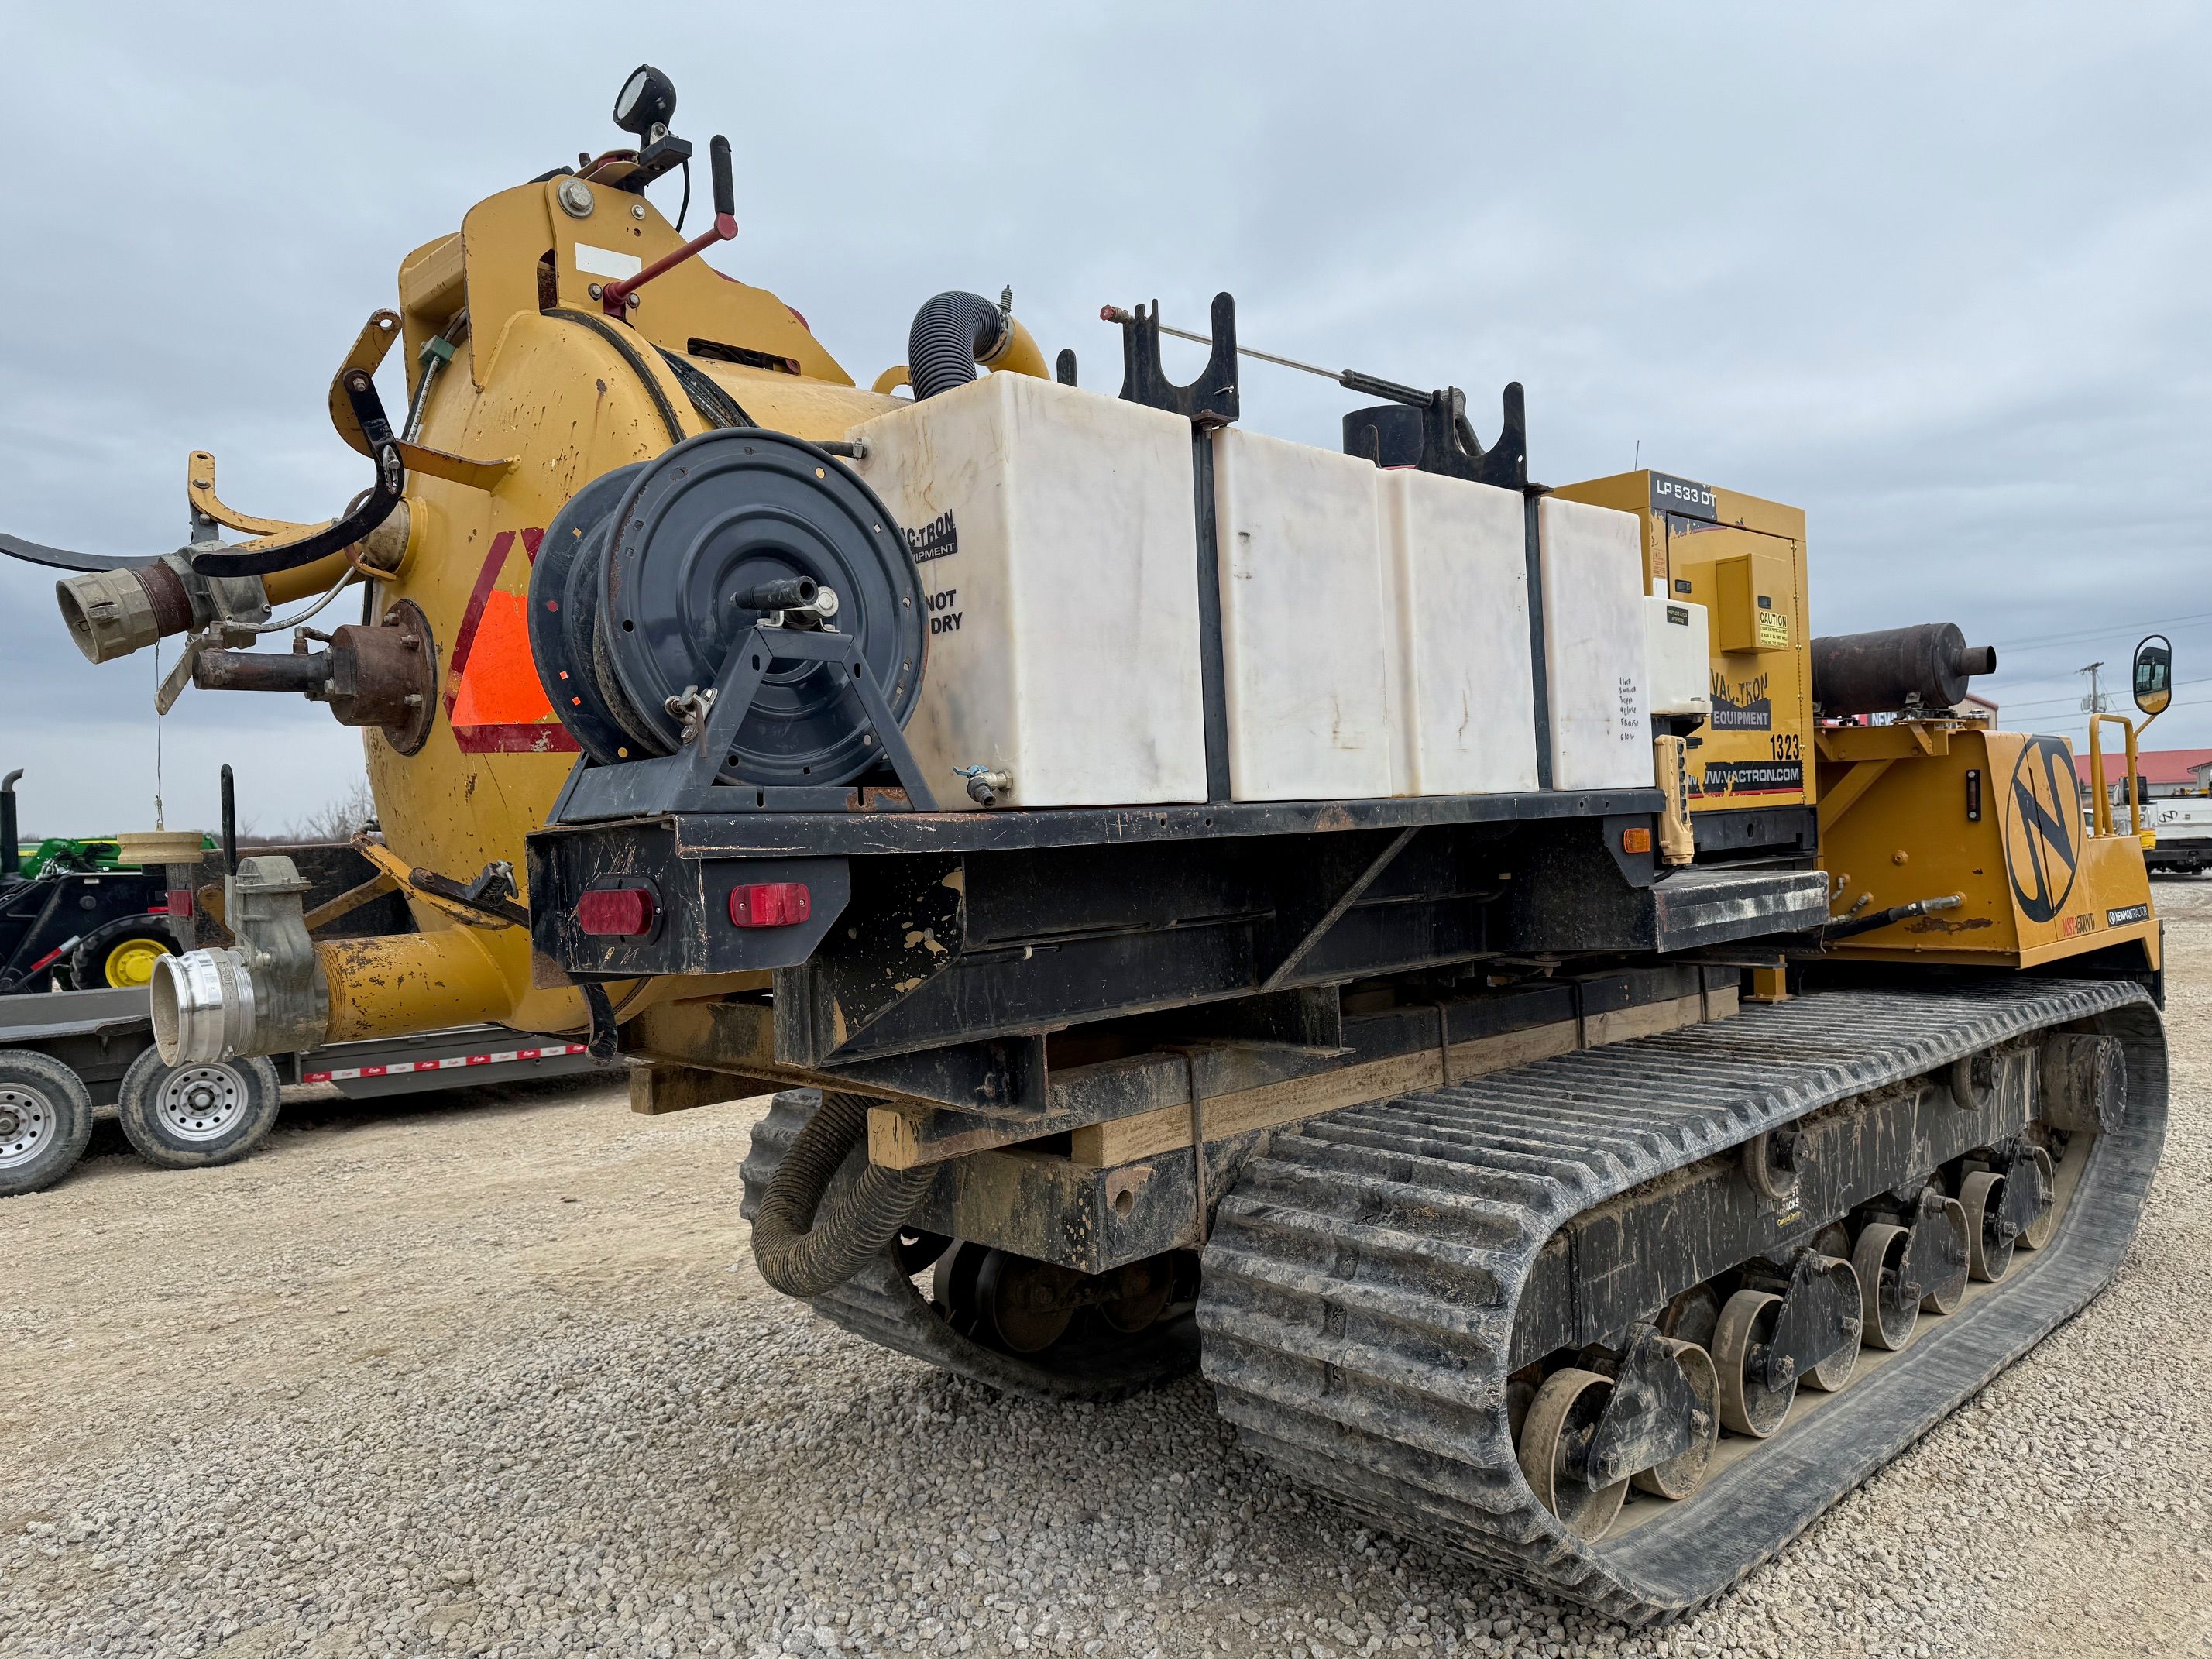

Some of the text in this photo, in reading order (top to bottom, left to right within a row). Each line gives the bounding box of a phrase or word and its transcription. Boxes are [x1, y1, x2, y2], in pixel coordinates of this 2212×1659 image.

[1657, 479, 1716, 507] LP 533 DT
[901, 508, 954, 548] C-TRON
[914, 542, 954, 562] IPMENT
[926, 589, 957, 612] NOT
[930, 612, 963, 635] DRY
[1760, 611, 1787, 627] CAUTION
[1713, 710, 1768, 726] EQUIPMENT
[1872, 711, 1898, 726] NEW
[1770, 733, 1800, 761] 1323
